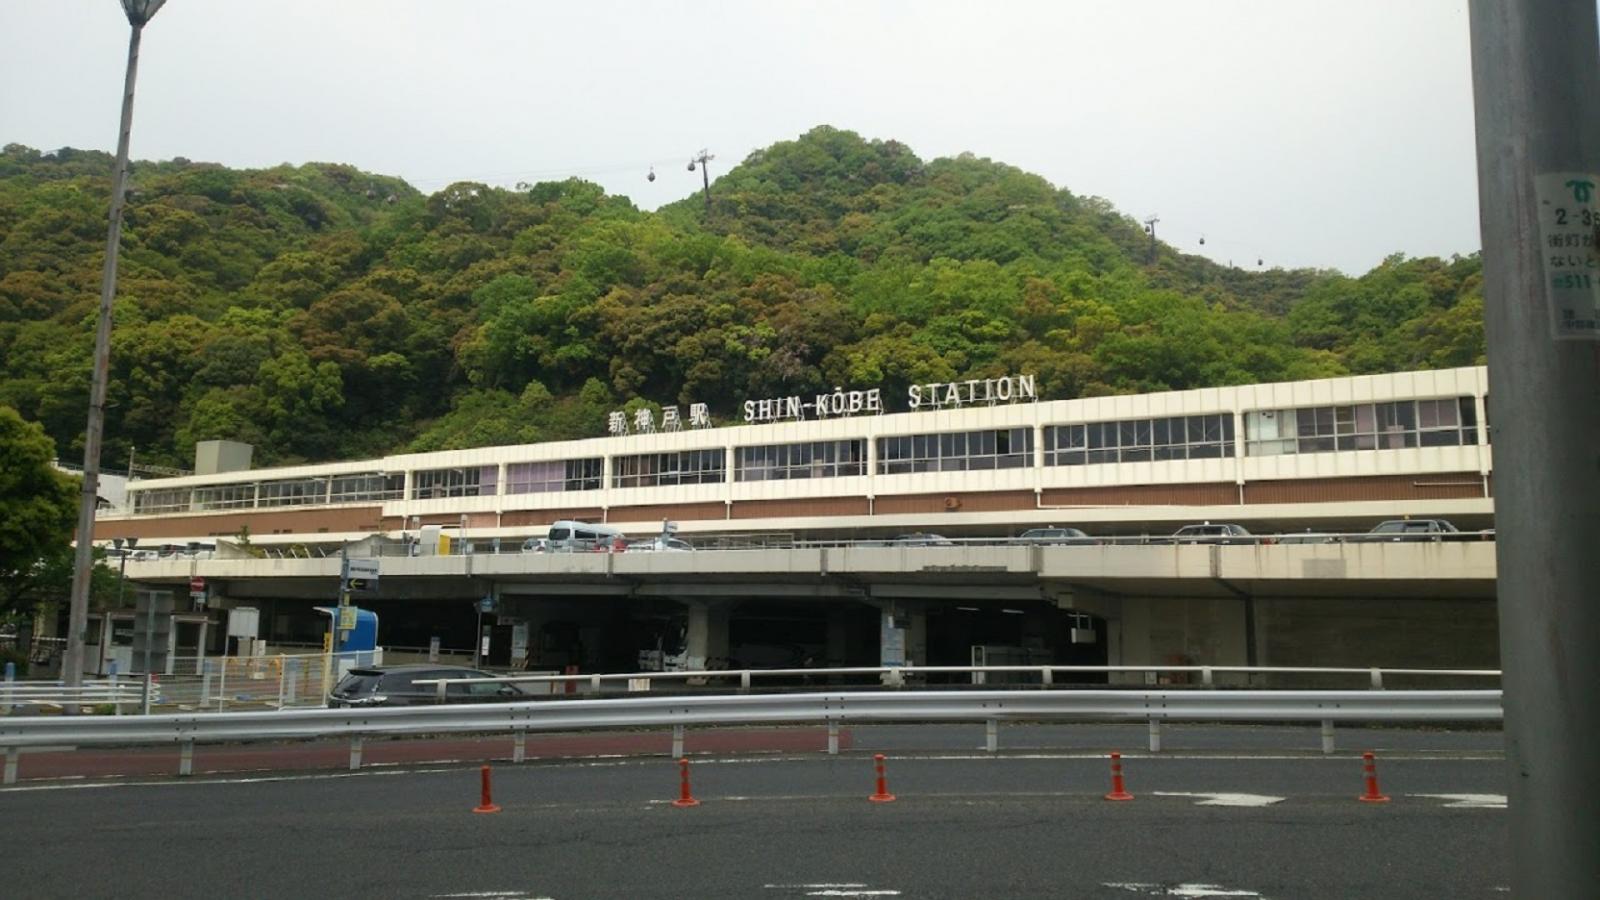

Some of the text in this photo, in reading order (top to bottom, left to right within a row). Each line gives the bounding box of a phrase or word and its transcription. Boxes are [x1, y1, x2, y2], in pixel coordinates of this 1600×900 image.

[743, 374, 1035, 421] SHIN-KŌBE STATION
[608, 402, 708, 433] 新神戸駅
